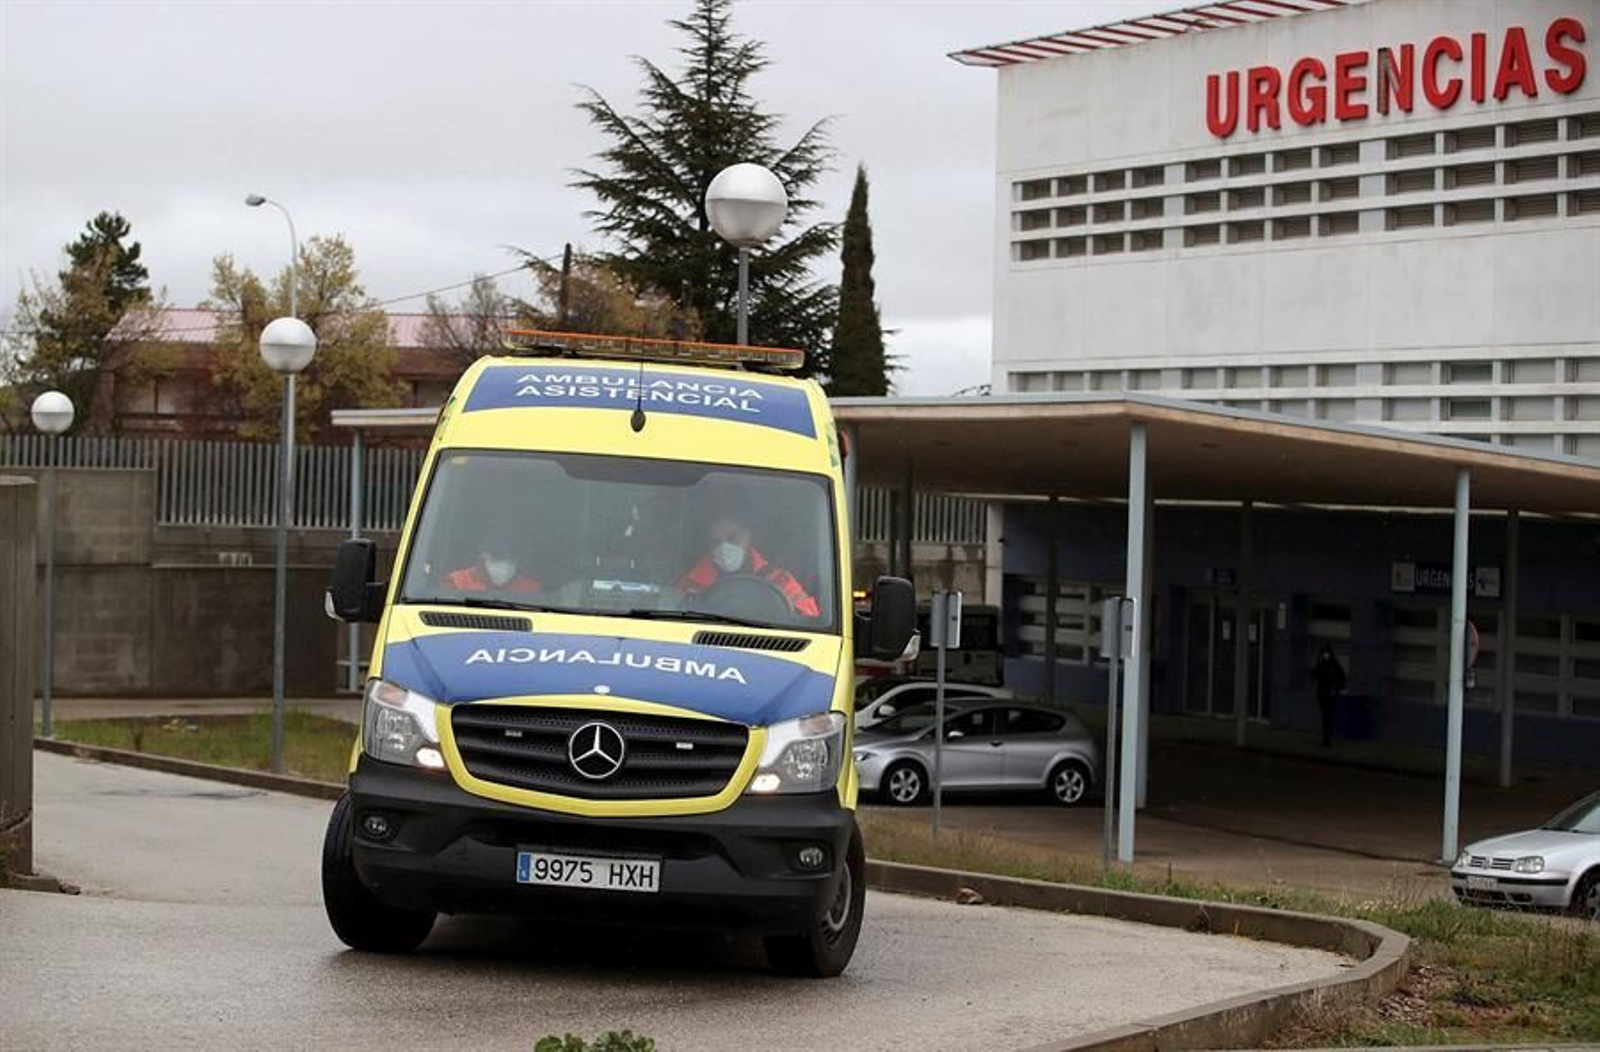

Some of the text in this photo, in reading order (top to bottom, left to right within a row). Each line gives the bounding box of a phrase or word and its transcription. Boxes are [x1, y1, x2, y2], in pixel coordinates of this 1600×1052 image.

[1206, 16, 1587, 138] URGENCIAS
[516, 373, 763, 400] AMBULANCIA
[516, 385, 761, 413] ASISTENCIAL
[1415, 568, 1475, 590] URGENS
[534, 858, 594, 883] 9975
[608, 863, 654, 888] HXH
